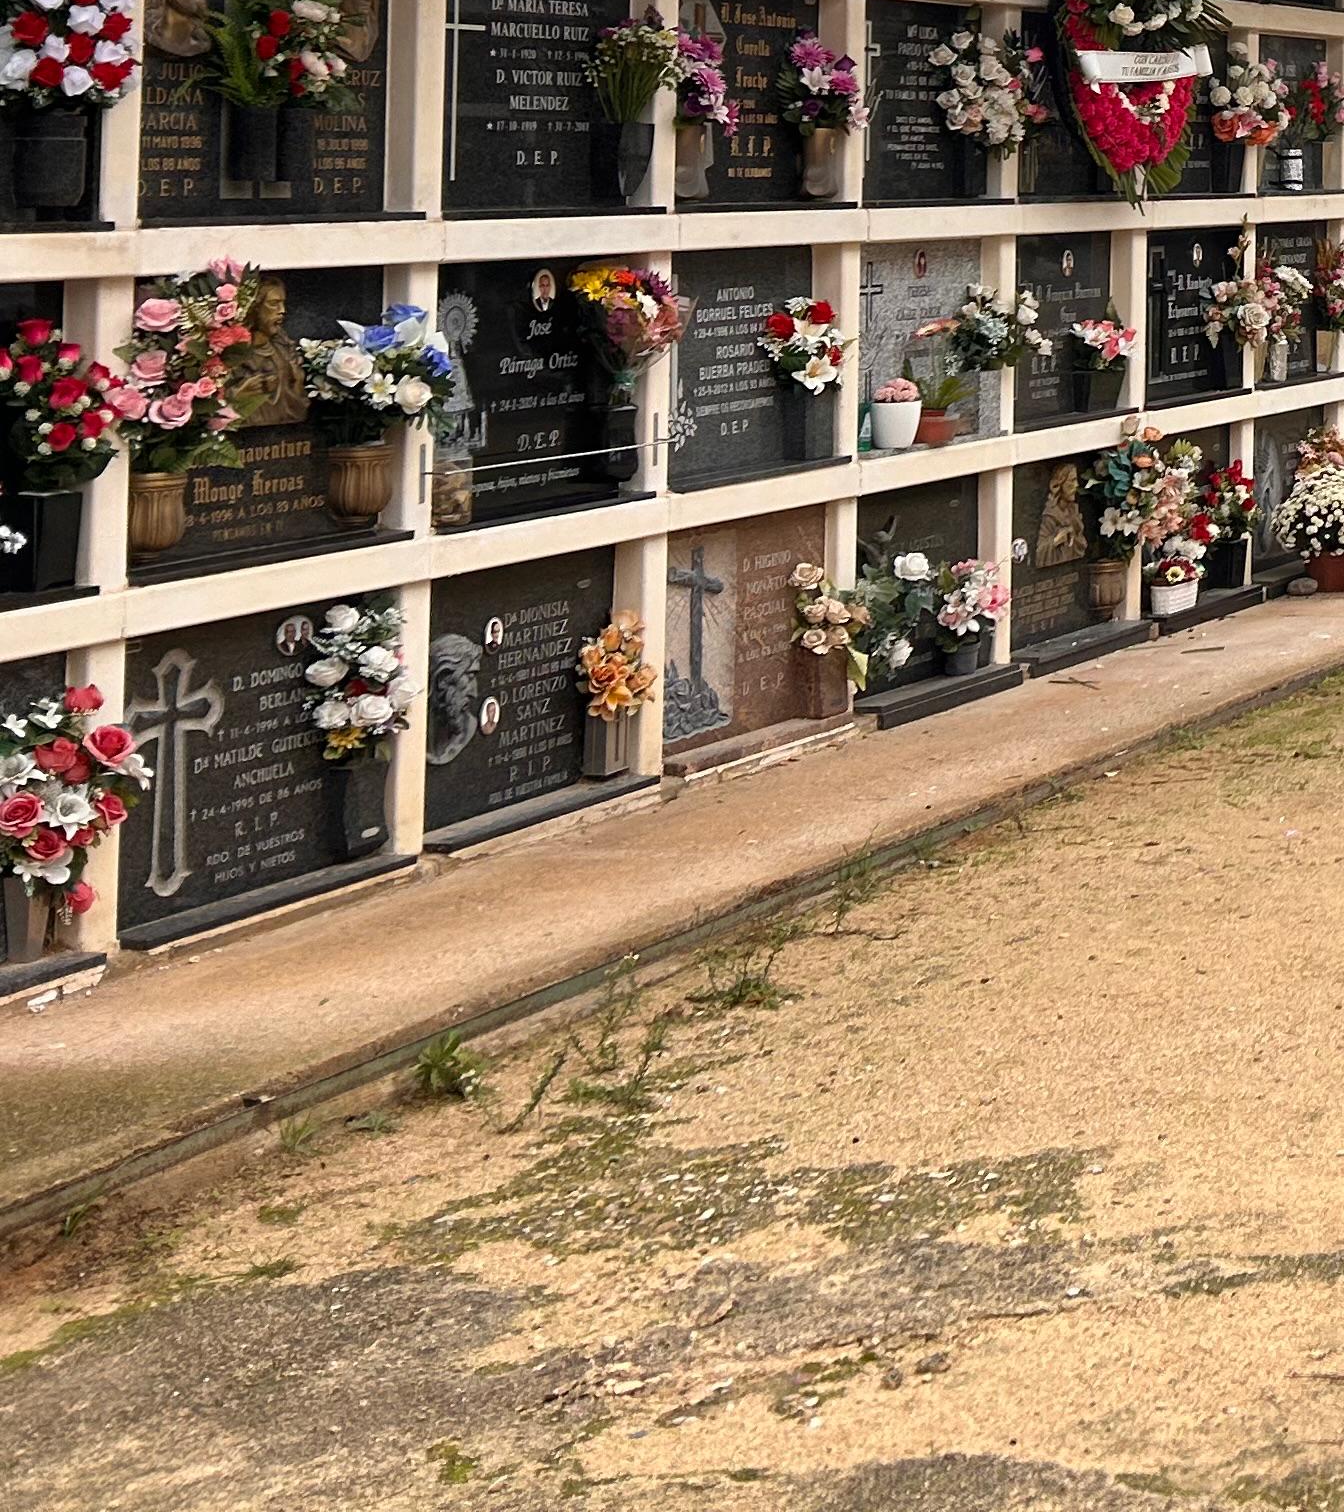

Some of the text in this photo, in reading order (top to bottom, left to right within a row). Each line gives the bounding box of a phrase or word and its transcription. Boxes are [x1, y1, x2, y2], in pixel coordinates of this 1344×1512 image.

[549, 0, 590, 18] TERESA
[490, 21, 590, 42] MARCUELLO RUIZ
[512, 69, 554, 86] VICTOR
[556, 71, 583, 87] RUIZ
[509, 94, 570, 111] MELENDEZ
[313, 115, 368, 133] MOLINA
[516, 149, 561, 166] D. E. P.
[716, 285, 755, 302] ANTONIO
[696, 302, 774, 324] BORRUEL FELICES
[526, 317, 553, 341] José
[715, 342, 755, 360] ROSARIO
[499, 351, 579, 380] Párraga Ortiz
[239, 439, 312, 465] naventura
[517, 433, 532, 453] D.
[534, 431, 547, 450] E.
[519, 600, 570, 625] DIONISIA
[502, 618, 569, 650] MARTINEZ
[498, 637, 574, 671] HERNANDEZ
[250, 661, 304, 688] DOMINGO
[512, 674, 568, 704] LORENZO
[516, 697, 551, 722] SANZ
[499, 714, 566, 748] MARTINEZ
[214, 742, 264, 770] MATILDE
[233, 761, 295, 790] ANCHUELA
